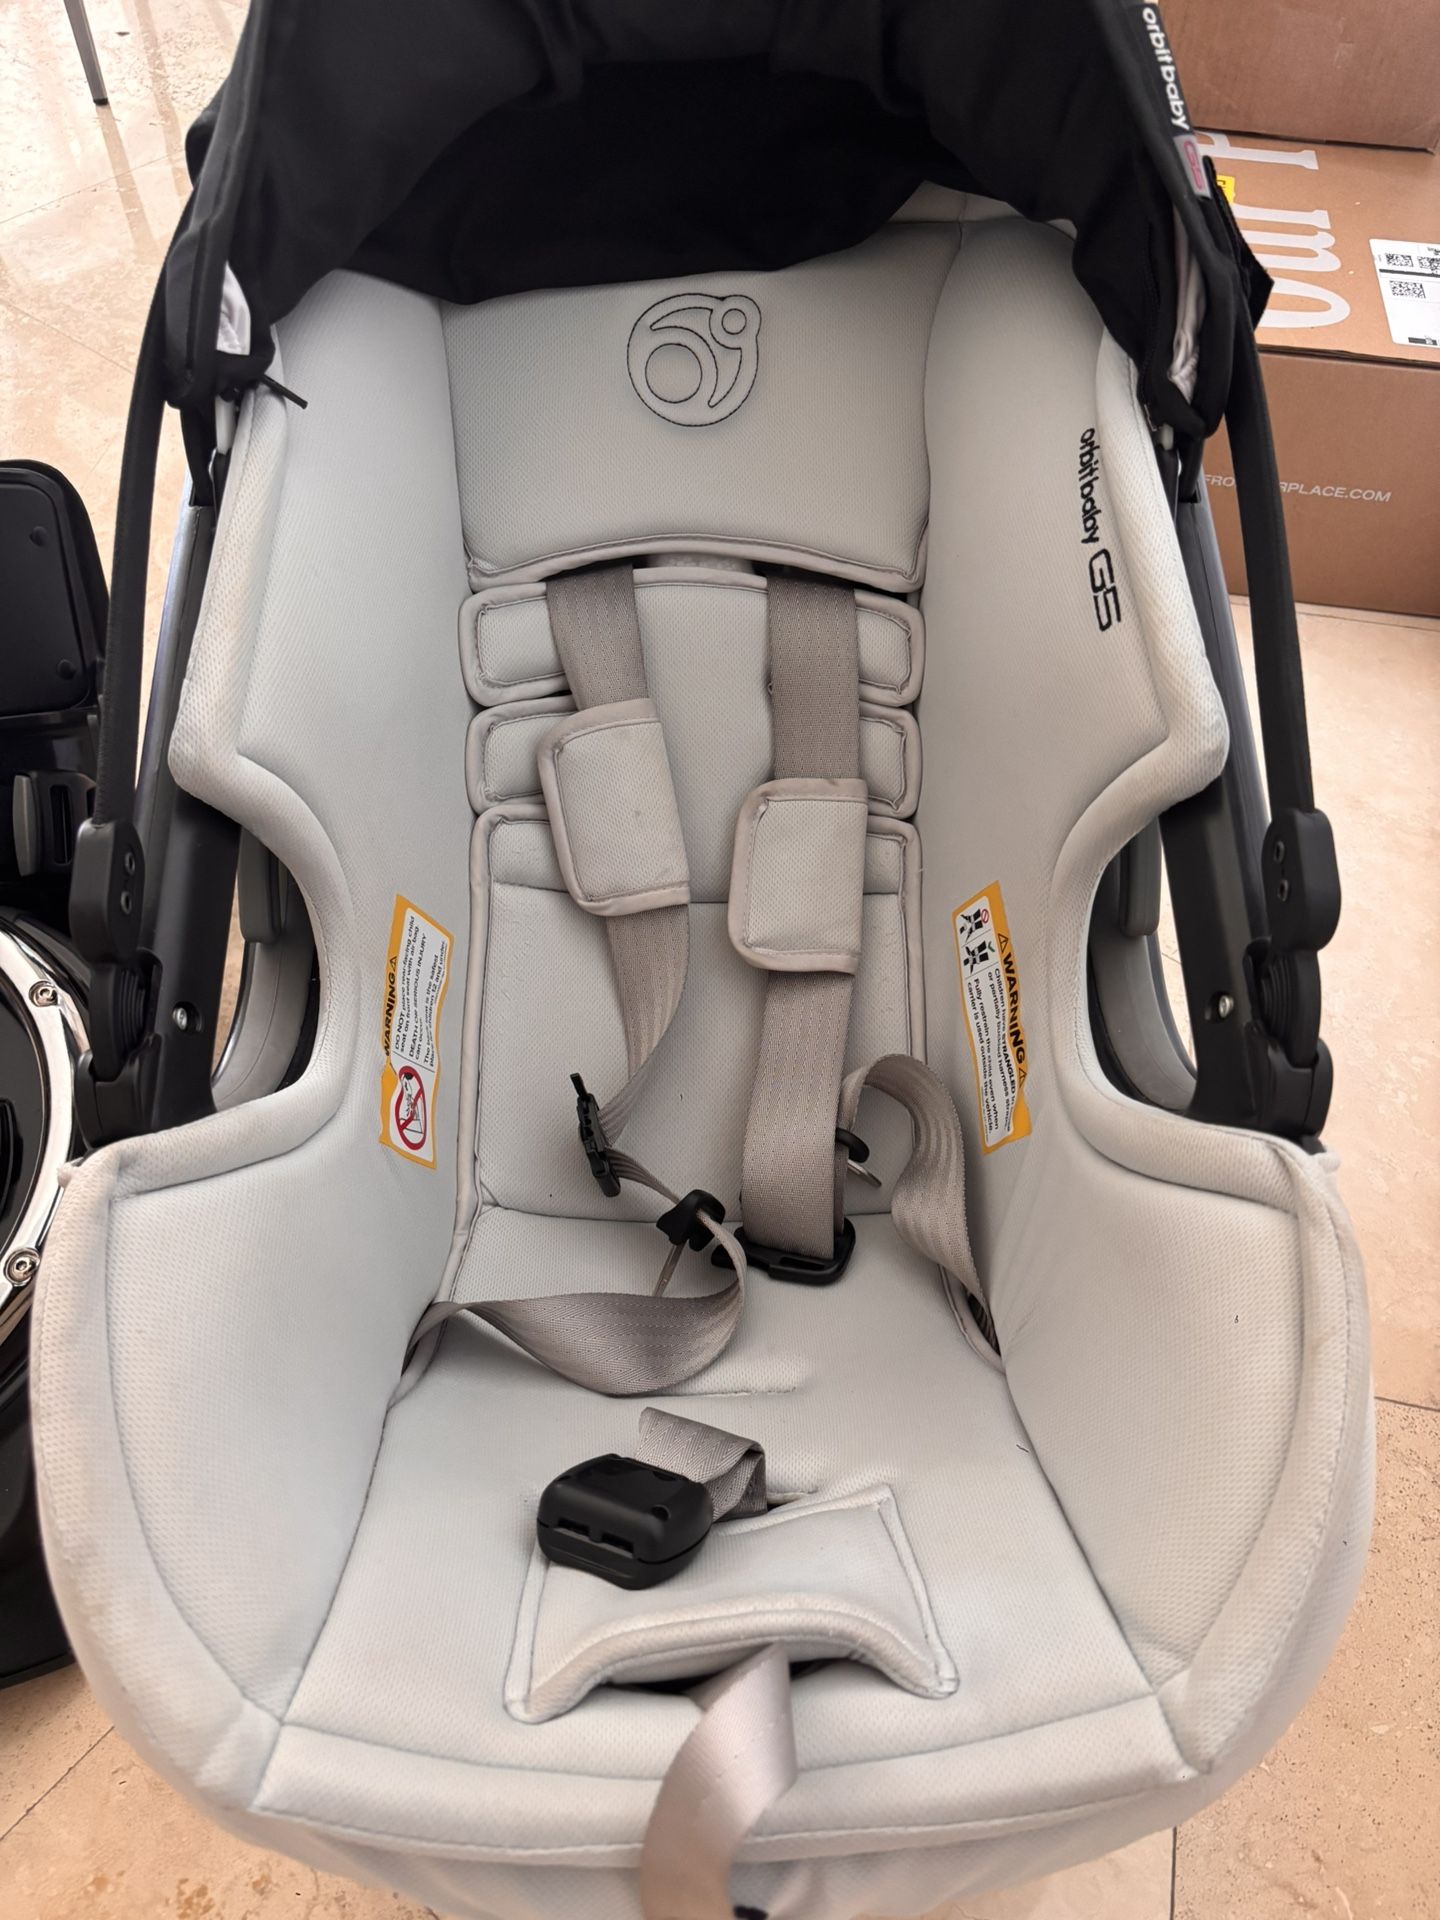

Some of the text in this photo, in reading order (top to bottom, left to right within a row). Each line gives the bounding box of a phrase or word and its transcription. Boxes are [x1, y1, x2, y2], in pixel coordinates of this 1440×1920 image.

[430, 954, 438, 979] safest
[988, 972, 993, 981] or
[409, 1025, 418, 1057] DEATH
[417, 933, 426, 967] INJURY
[968, 982, 977, 1010] carrier
[976, 1022, 984, 1044] used
[974, 978, 982, 1000] Fully
[979, 1002, 989, 1036] restrain
[989, 983, 1001, 1020] partially
[1003, 952, 1025, 1064] WARNING
[384, 972, 395, 1056] WARNING
[397, 1012, 405, 1032] NOT
[404, 1021, 409, 1032] on
[995, 968, 1006, 1007] Children
[1002, 1033, 1016, 1094] STRANGLED
[395, 1034, 400, 1049] DO
[998, 1060, 1008, 1097] harness
